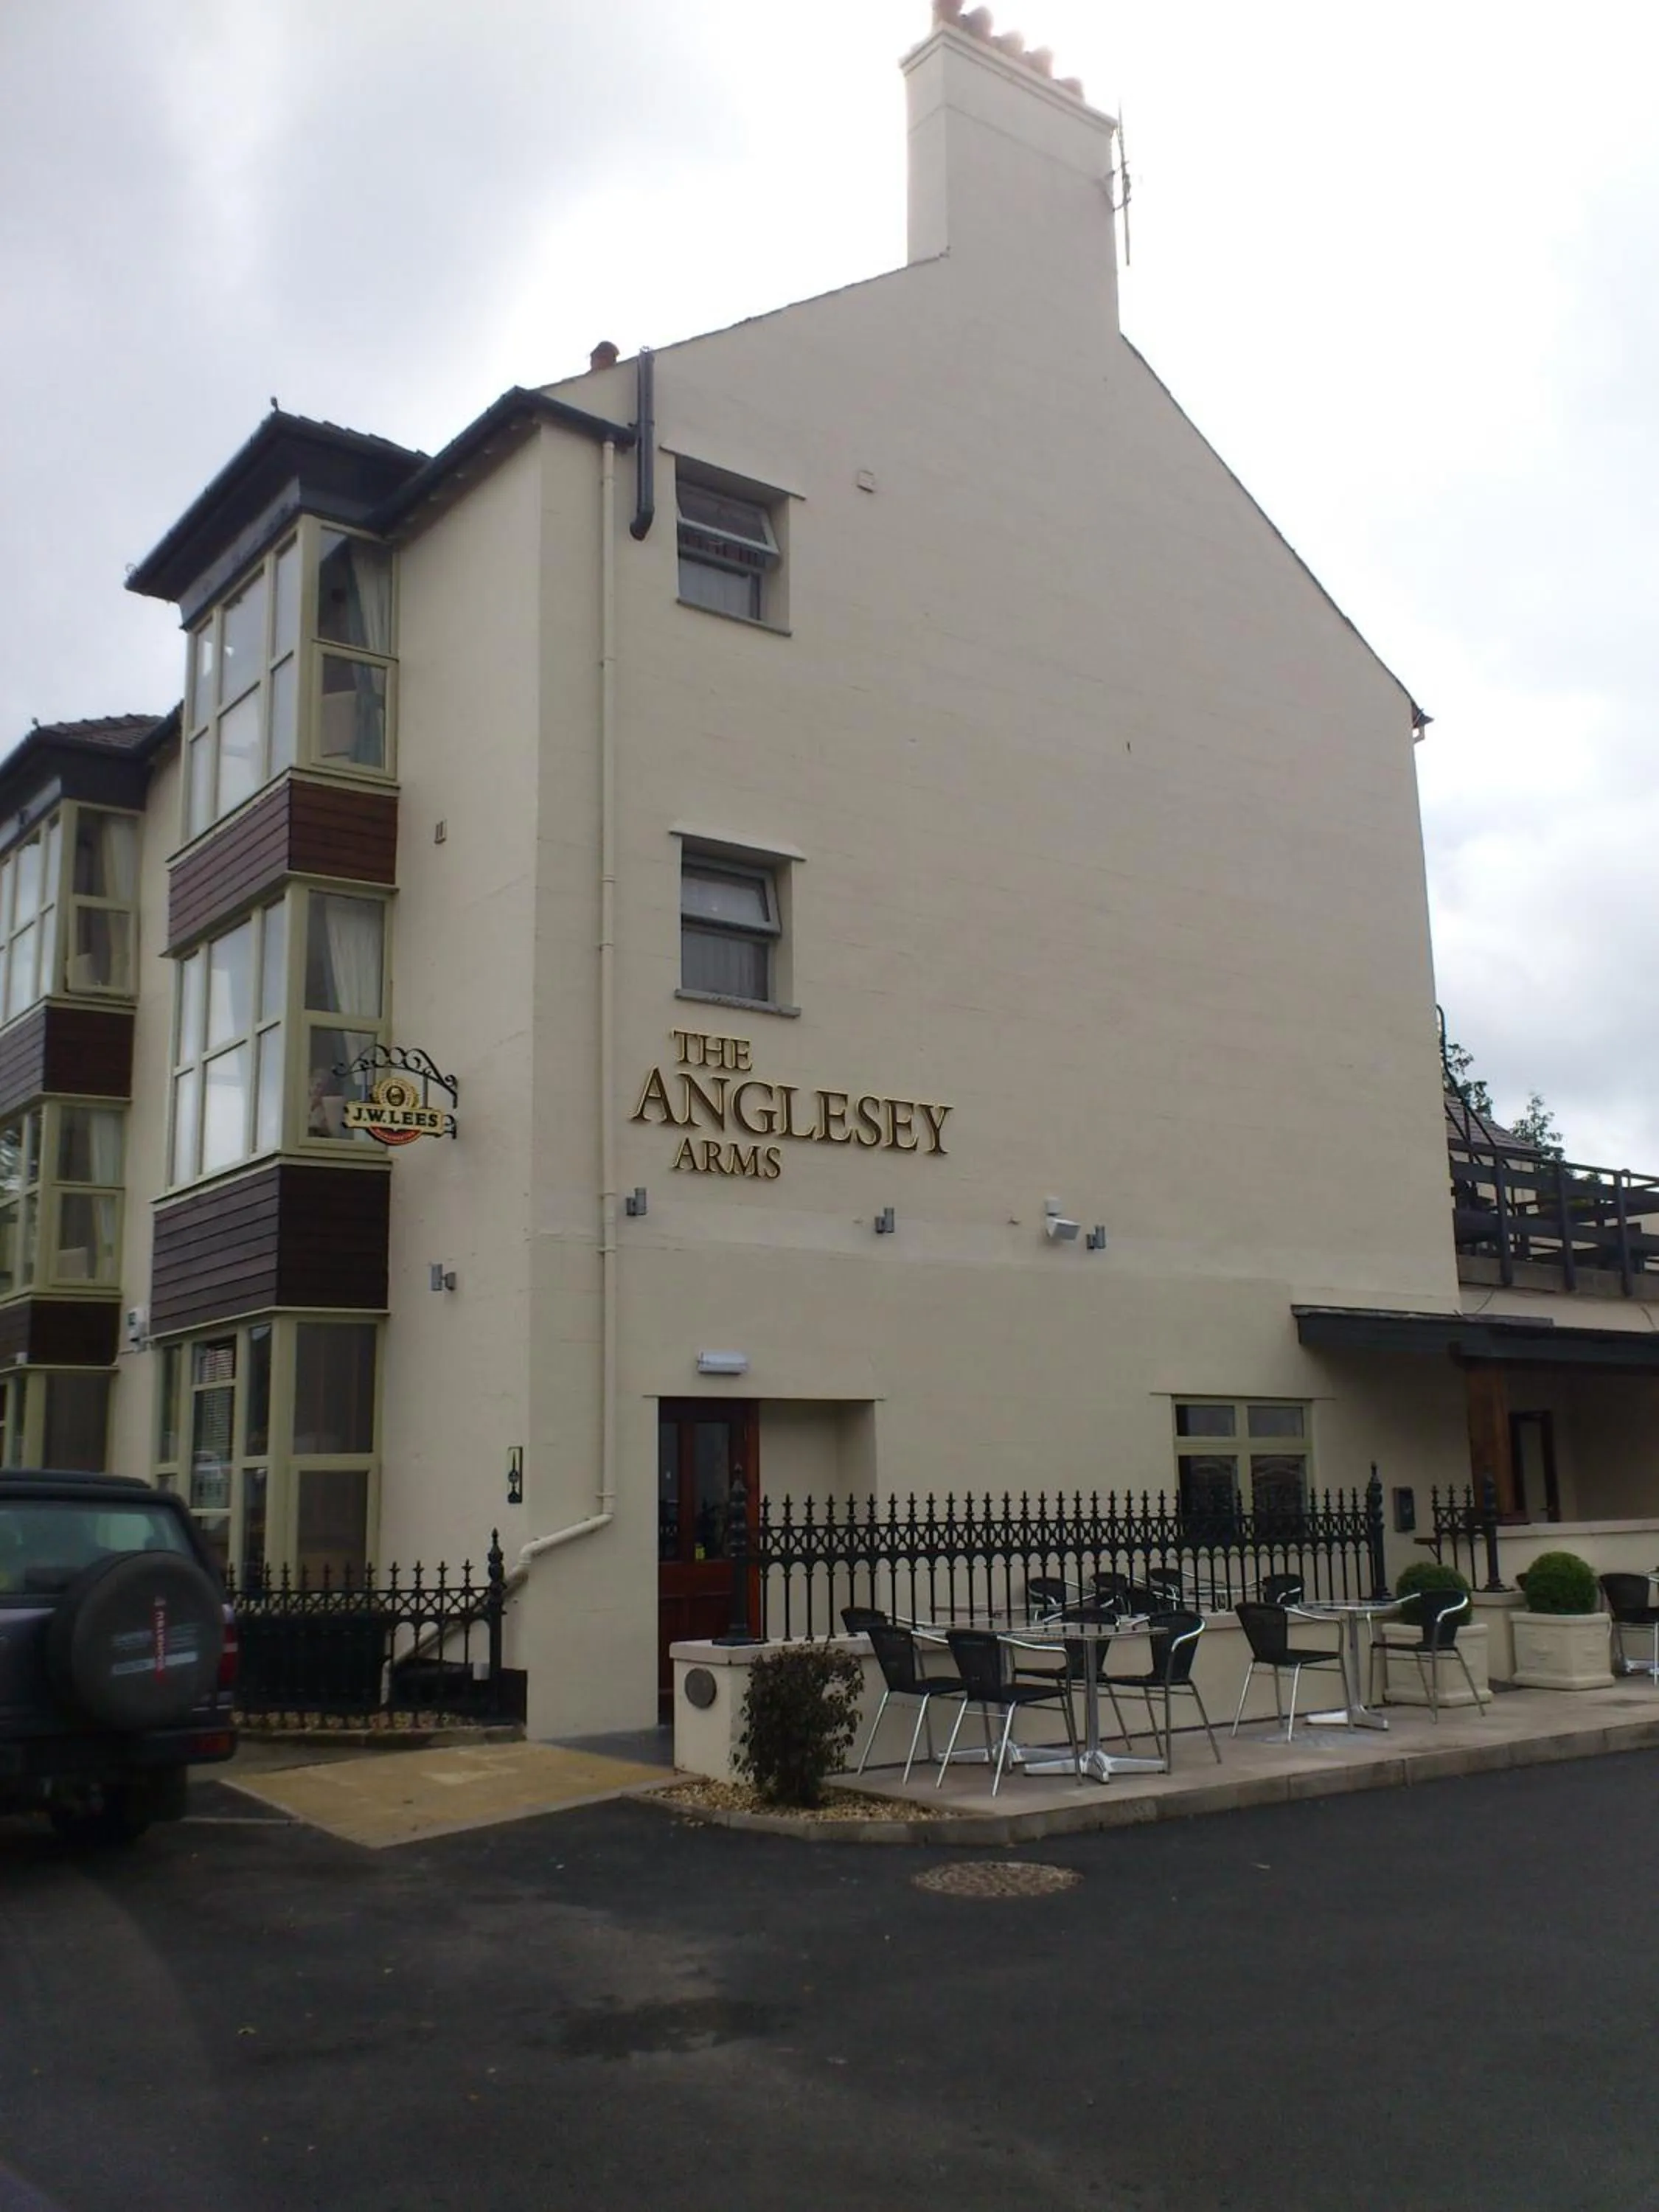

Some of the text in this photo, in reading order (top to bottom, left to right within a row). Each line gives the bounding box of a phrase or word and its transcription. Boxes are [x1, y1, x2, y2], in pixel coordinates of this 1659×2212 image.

[672, 1030, 753, 1071] THE
[630, 1065, 954, 1155] ANGLESEY
[673, 1138, 782, 1180] ARMS
